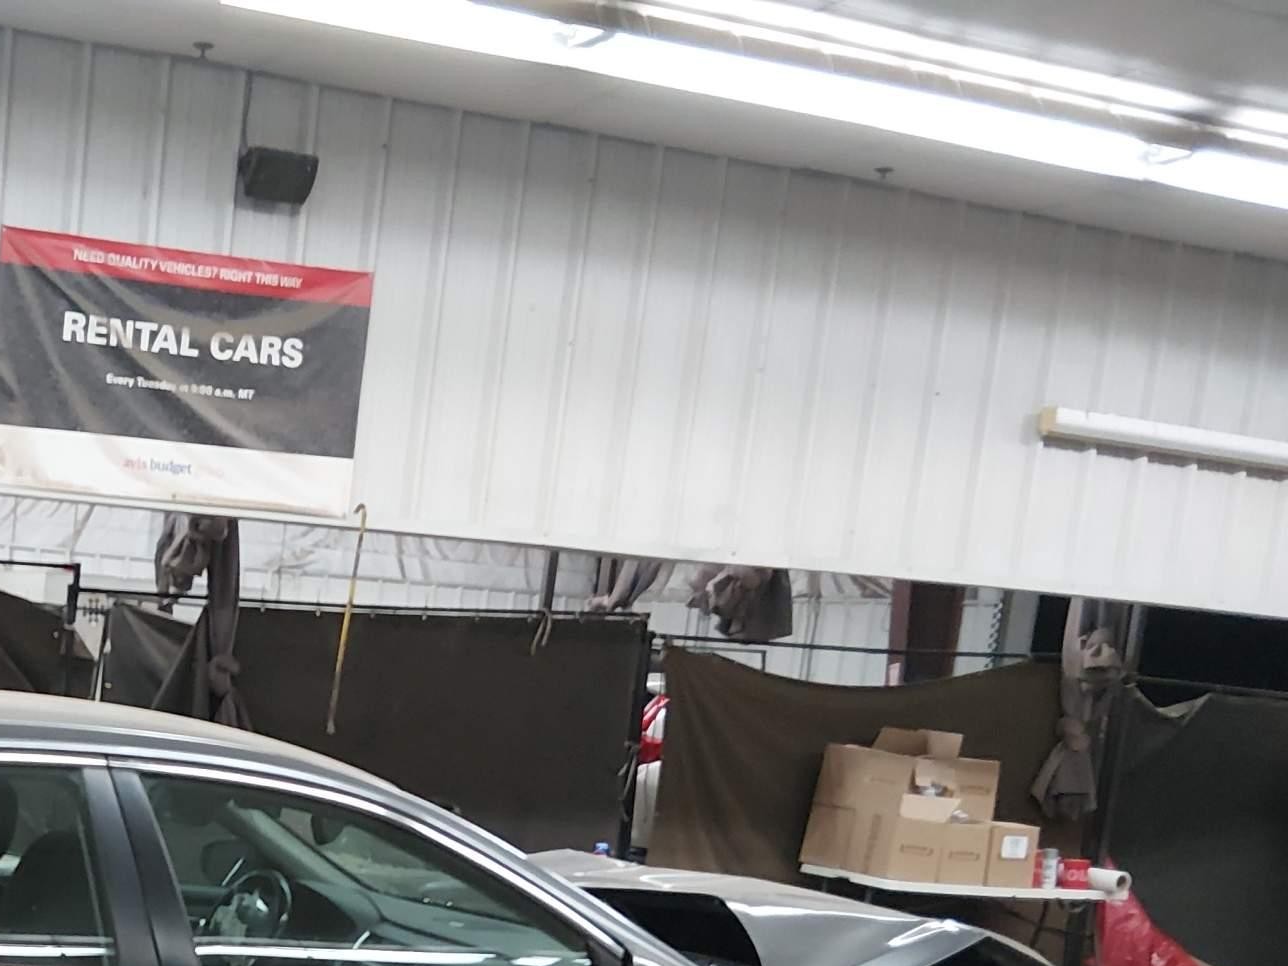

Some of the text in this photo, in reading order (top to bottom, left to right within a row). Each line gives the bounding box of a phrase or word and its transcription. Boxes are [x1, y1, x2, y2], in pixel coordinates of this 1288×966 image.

[72, 248, 303, 289] NEED QUALITY VEHICLES? RIGHT THIS WAY
[62, 310, 304, 368] RENTAL CARS
[106, 373, 135, 388] Every
[150, 457, 192, 475] budget
